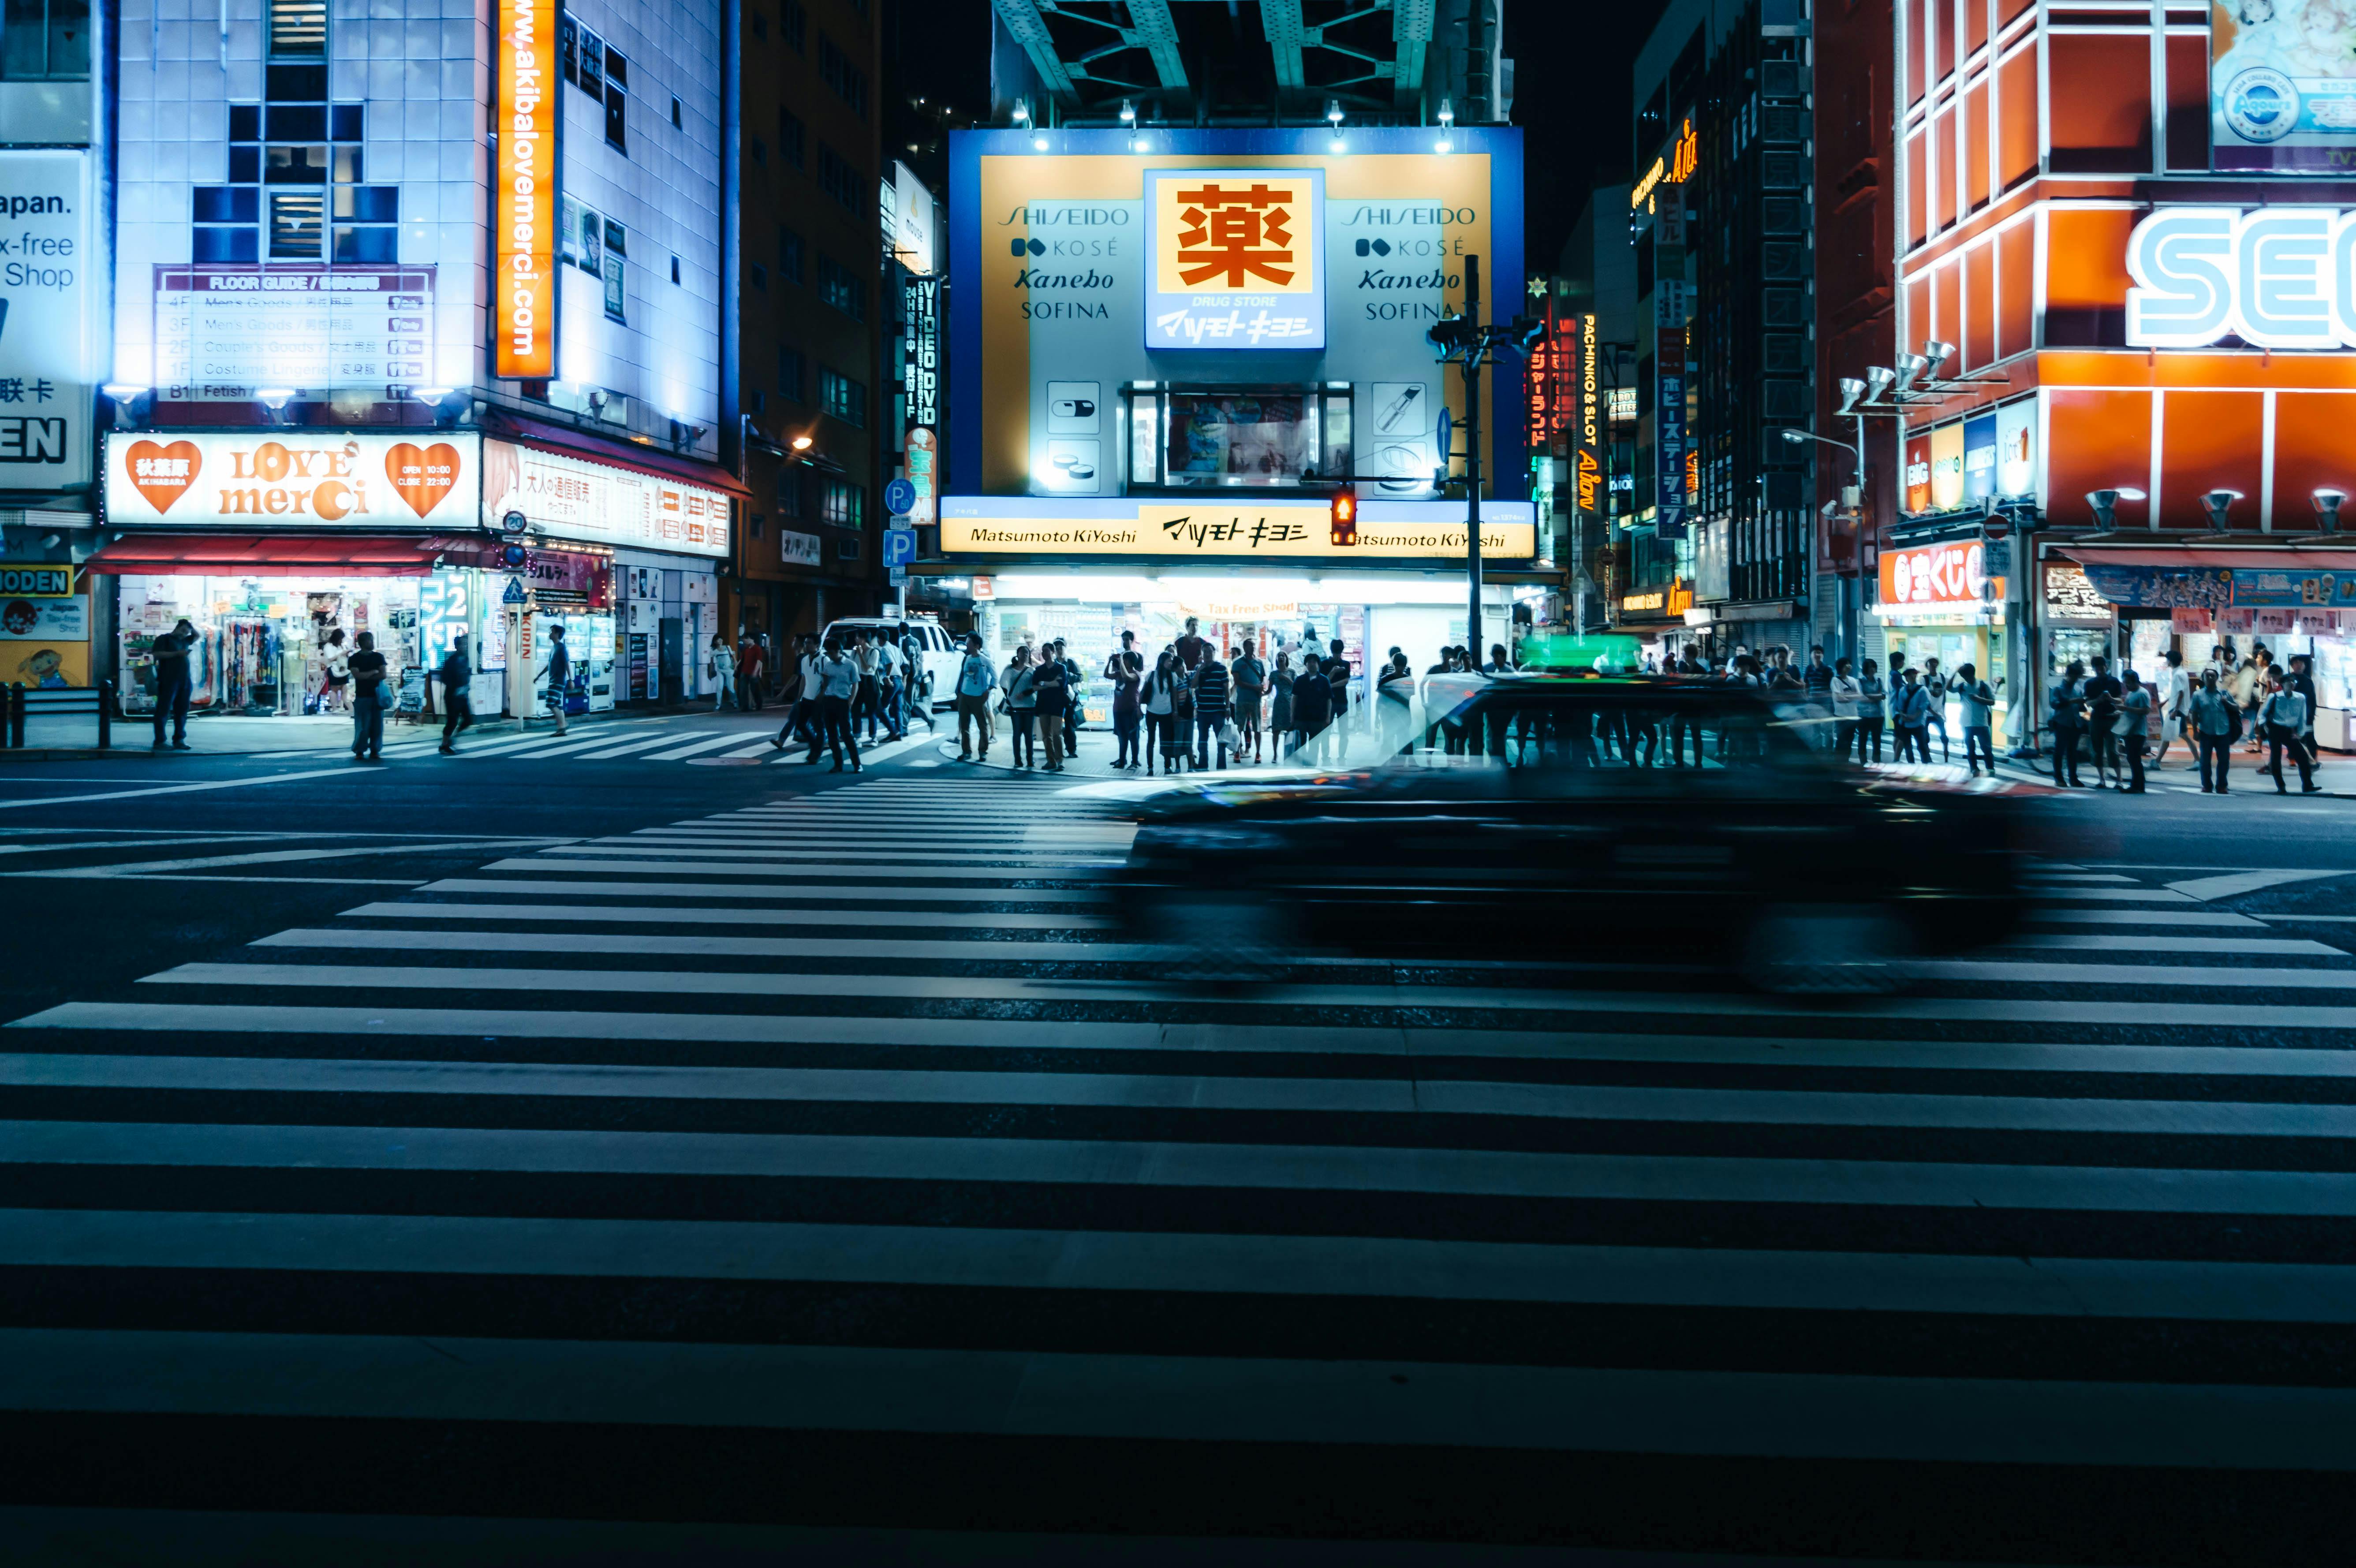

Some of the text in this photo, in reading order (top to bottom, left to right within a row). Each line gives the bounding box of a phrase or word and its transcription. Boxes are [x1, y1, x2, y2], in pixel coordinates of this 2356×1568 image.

[997, 206, 1129, 226] SHISEIDO
[1340, 206, 1476, 226] SHISEIDO
[906, 218, 923, 243] mouse
[1177, 184, 1295, 287] 薬
[1053, 236, 1118, 257] KOSÉ
[1399, 236, 1464, 257] KOSÉ
[5, 262, 74, 290] Shop
[210, 276, 259, 290] FLOOR
[261, 276, 308, 290] GUIDE
[1014, 268, 1114, 289] Kanebo
[1358, 268, 1460, 290] Kanebo
[2125, 207, 2356, 349] SE
[1022, 301, 1109, 319] SOFINA
[1192, 297, 1277, 307] DRUG STORE
[1366, 302, 1455, 320] SOFINA
[205, 319, 243, 330] Men's
[247, 319, 292, 331] Goods
[923, 281, 936, 368] VIDEO
[1157, 309, 1314, 345] マツモトキヨシ
[205, 341, 263, 356] Couple's
[205, 363, 268, 374] Costume
[204, 384, 246, 397] Fetish
[1583, 315, 1596, 446] PACHINKO & SLOT
[923, 372, 936, 425] DVD
[1663, 378, 1681, 523] ホビーステーション
[135, 458, 190, 477] 秋葉原
[229, 441, 355, 482] LOVE
[402, 465, 451, 474] OPEN 10:00
[398, 477, 451, 486] CLOSE 22:00
[1907, 462, 1929, 487] BIG
[527, 471, 590, 504] 大人の通信販売
[892, 487, 904, 509] P
[509, 517, 523, 528] 20
[1163, 516, 1309, 548] マツモトキヨシ
[971, 528, 1137, 544] Matsumoto KiYoshi
[1355, 533, 1505, 547] atsumoto KiYshi
[892, 534, 910, 563] P
[1910, 549, 1966, 601] 宝くじ
[2047, 588, 2079, 599] アニメ
[1208, 603, 1229, 614] Tax
[1232, 604, 1260, 614] Free
[59, 624, 80, 633] Shop
[522, 615, 531, 659] KIRIN
